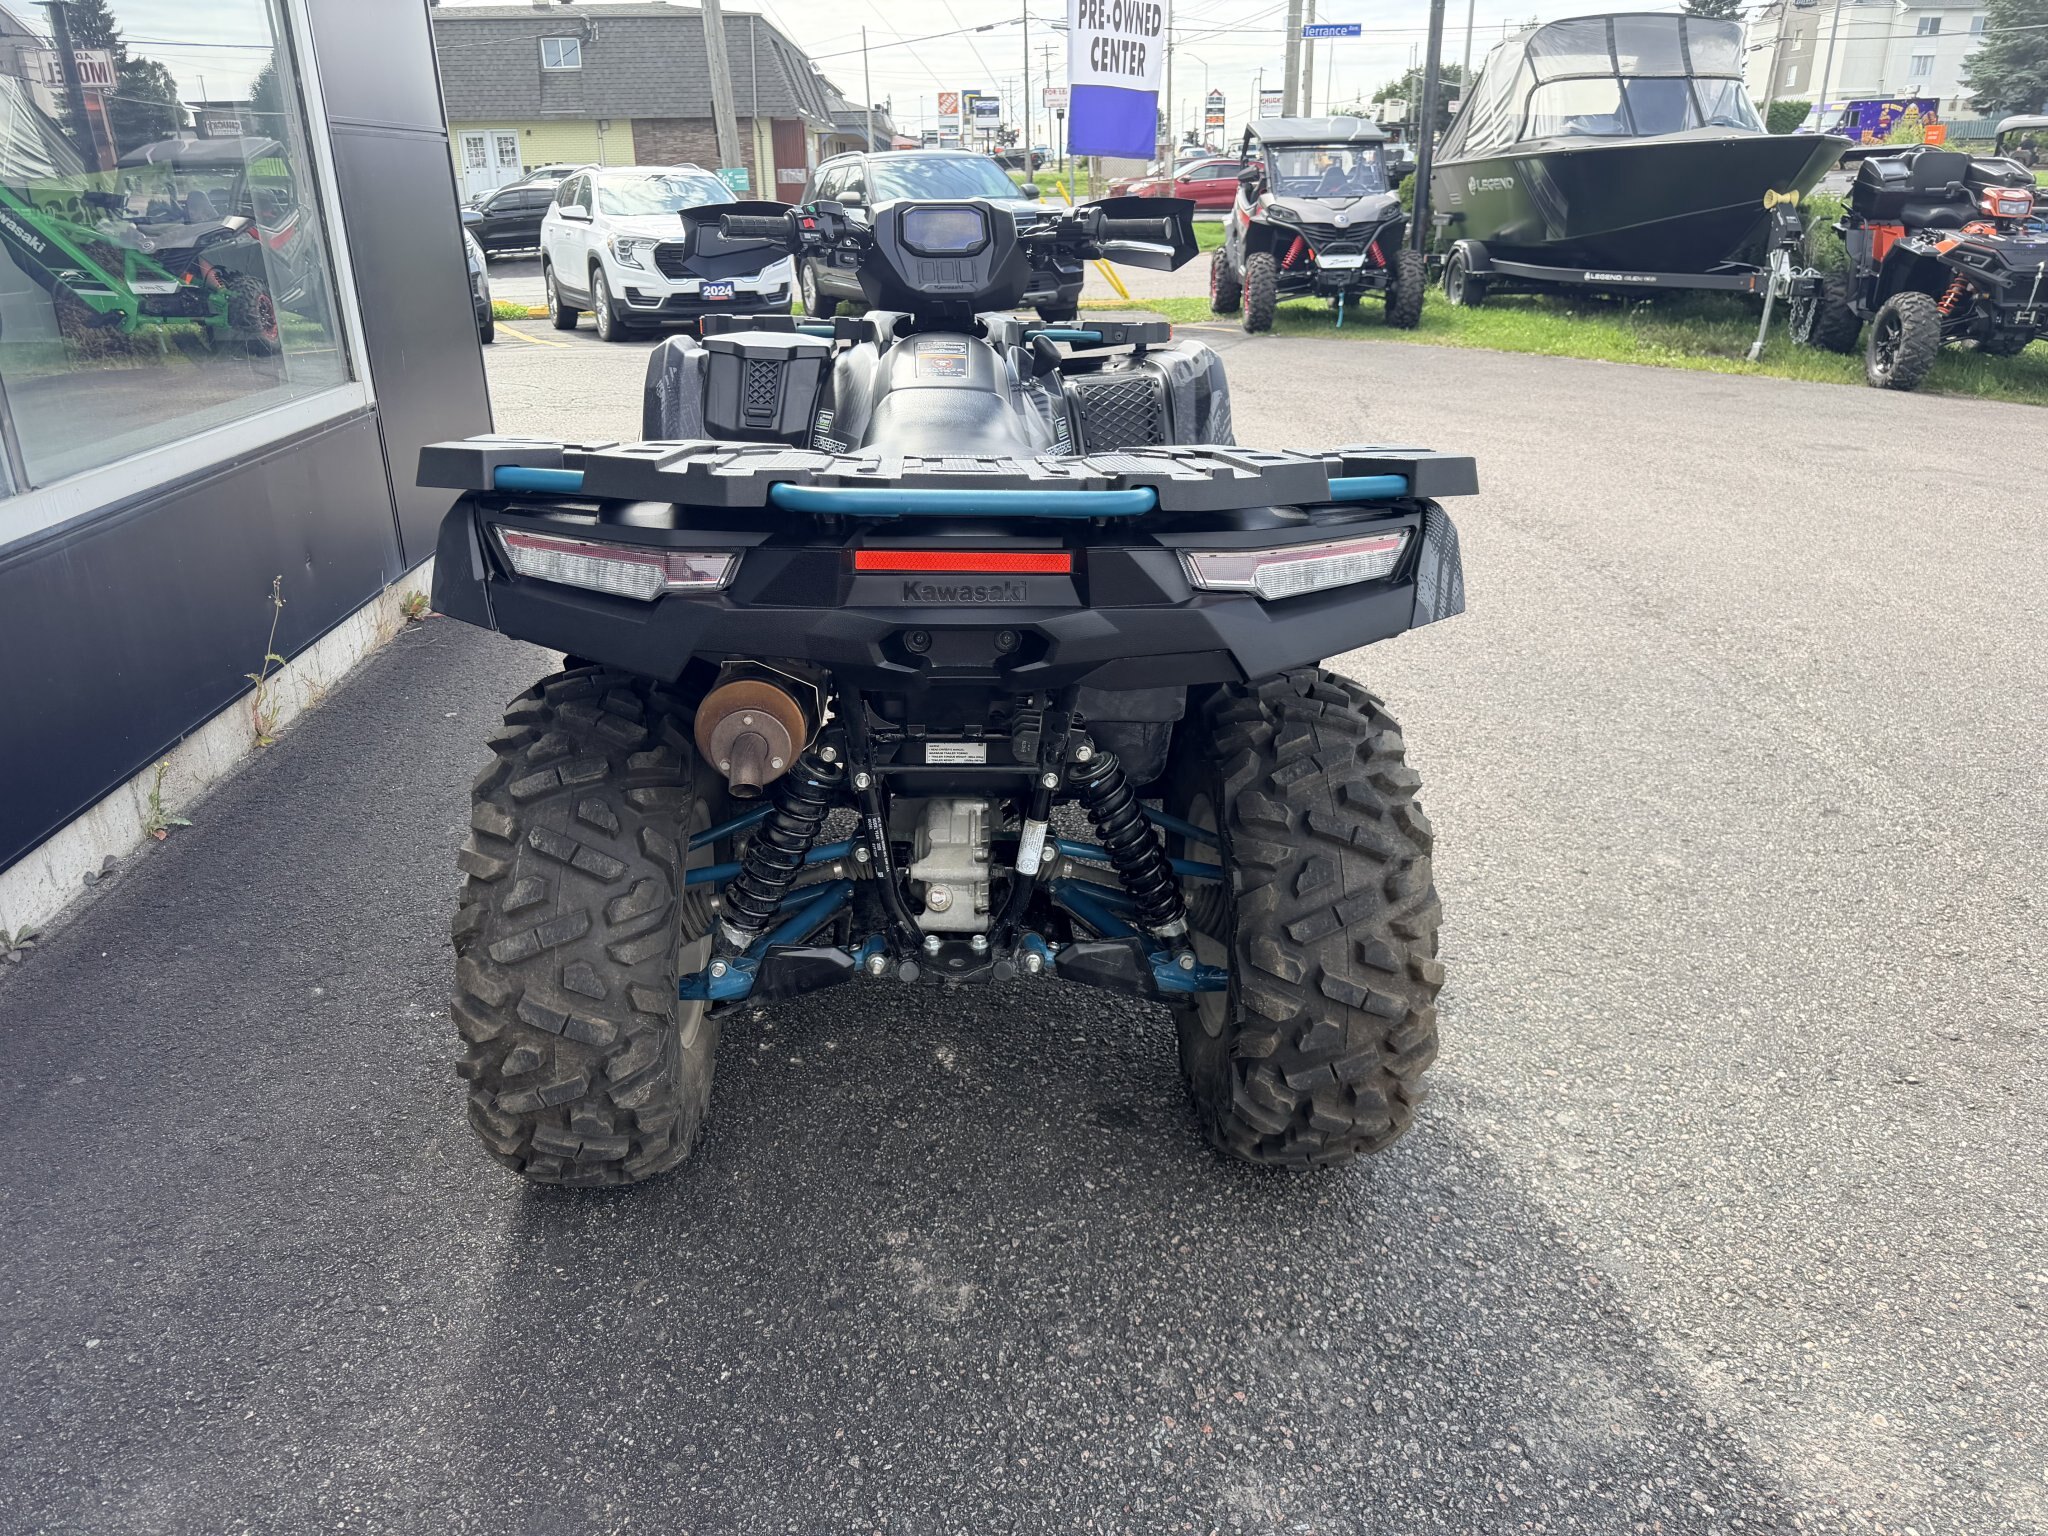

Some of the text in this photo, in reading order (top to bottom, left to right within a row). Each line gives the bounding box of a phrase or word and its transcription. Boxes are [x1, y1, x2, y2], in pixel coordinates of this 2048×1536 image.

[1078, 0, 1162, 37] PRE-OWNED
[1305, 26, 1348, 36] Terrance
[1090, 36, 1146, 77] CENTER
[1477, 177, 1514, 191] LEGEND
[703, 285, 733, 296] 2024
[903, 581, 1027, 602] Kawasaki
